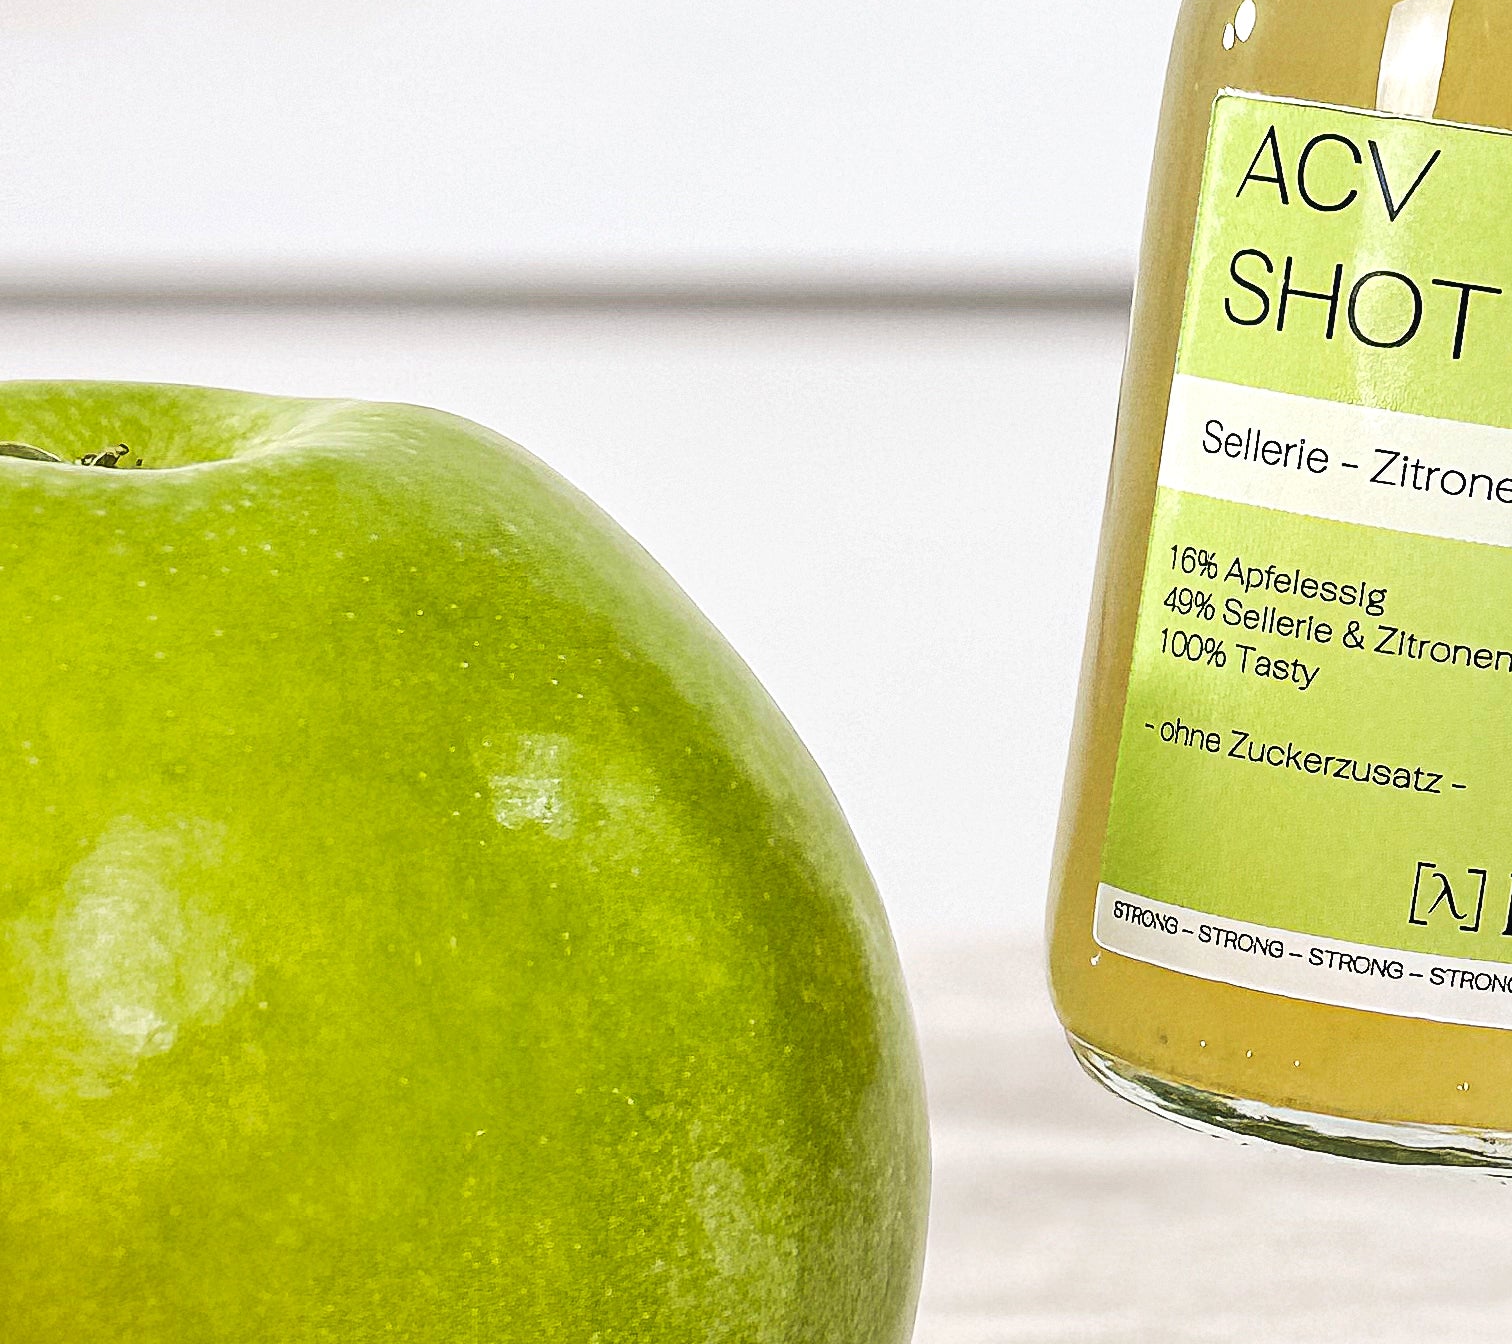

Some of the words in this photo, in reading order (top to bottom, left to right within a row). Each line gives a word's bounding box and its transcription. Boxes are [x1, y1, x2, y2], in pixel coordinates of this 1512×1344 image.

[1235, 124, 1442, 223] ACV
[1224, 248, 1503, 360] SHOT
[1202, 419, 1329, 474] Sellerie
[1163, 586, 1216, 621] 49%
[1222, 597, 1333, 644] Sellerie
[1342, 620, 1365, 650] &
[1170, 544, 1218, 580] 16%
[1223, 556, 1388, 617] Apfelessig
[1161, 627, 1227, 668] 100%
[1235, 643, 1321, 691] Tasty
[1160, 717, 1221, 753] ohne
[1227, 729, 1444, 794] Zuckerzusatz
[1113, 900, 1179, 935] STRONG
[1197, 924, 1284, 959] STRONG
[1308, 947, 1404, 980] STRONG
